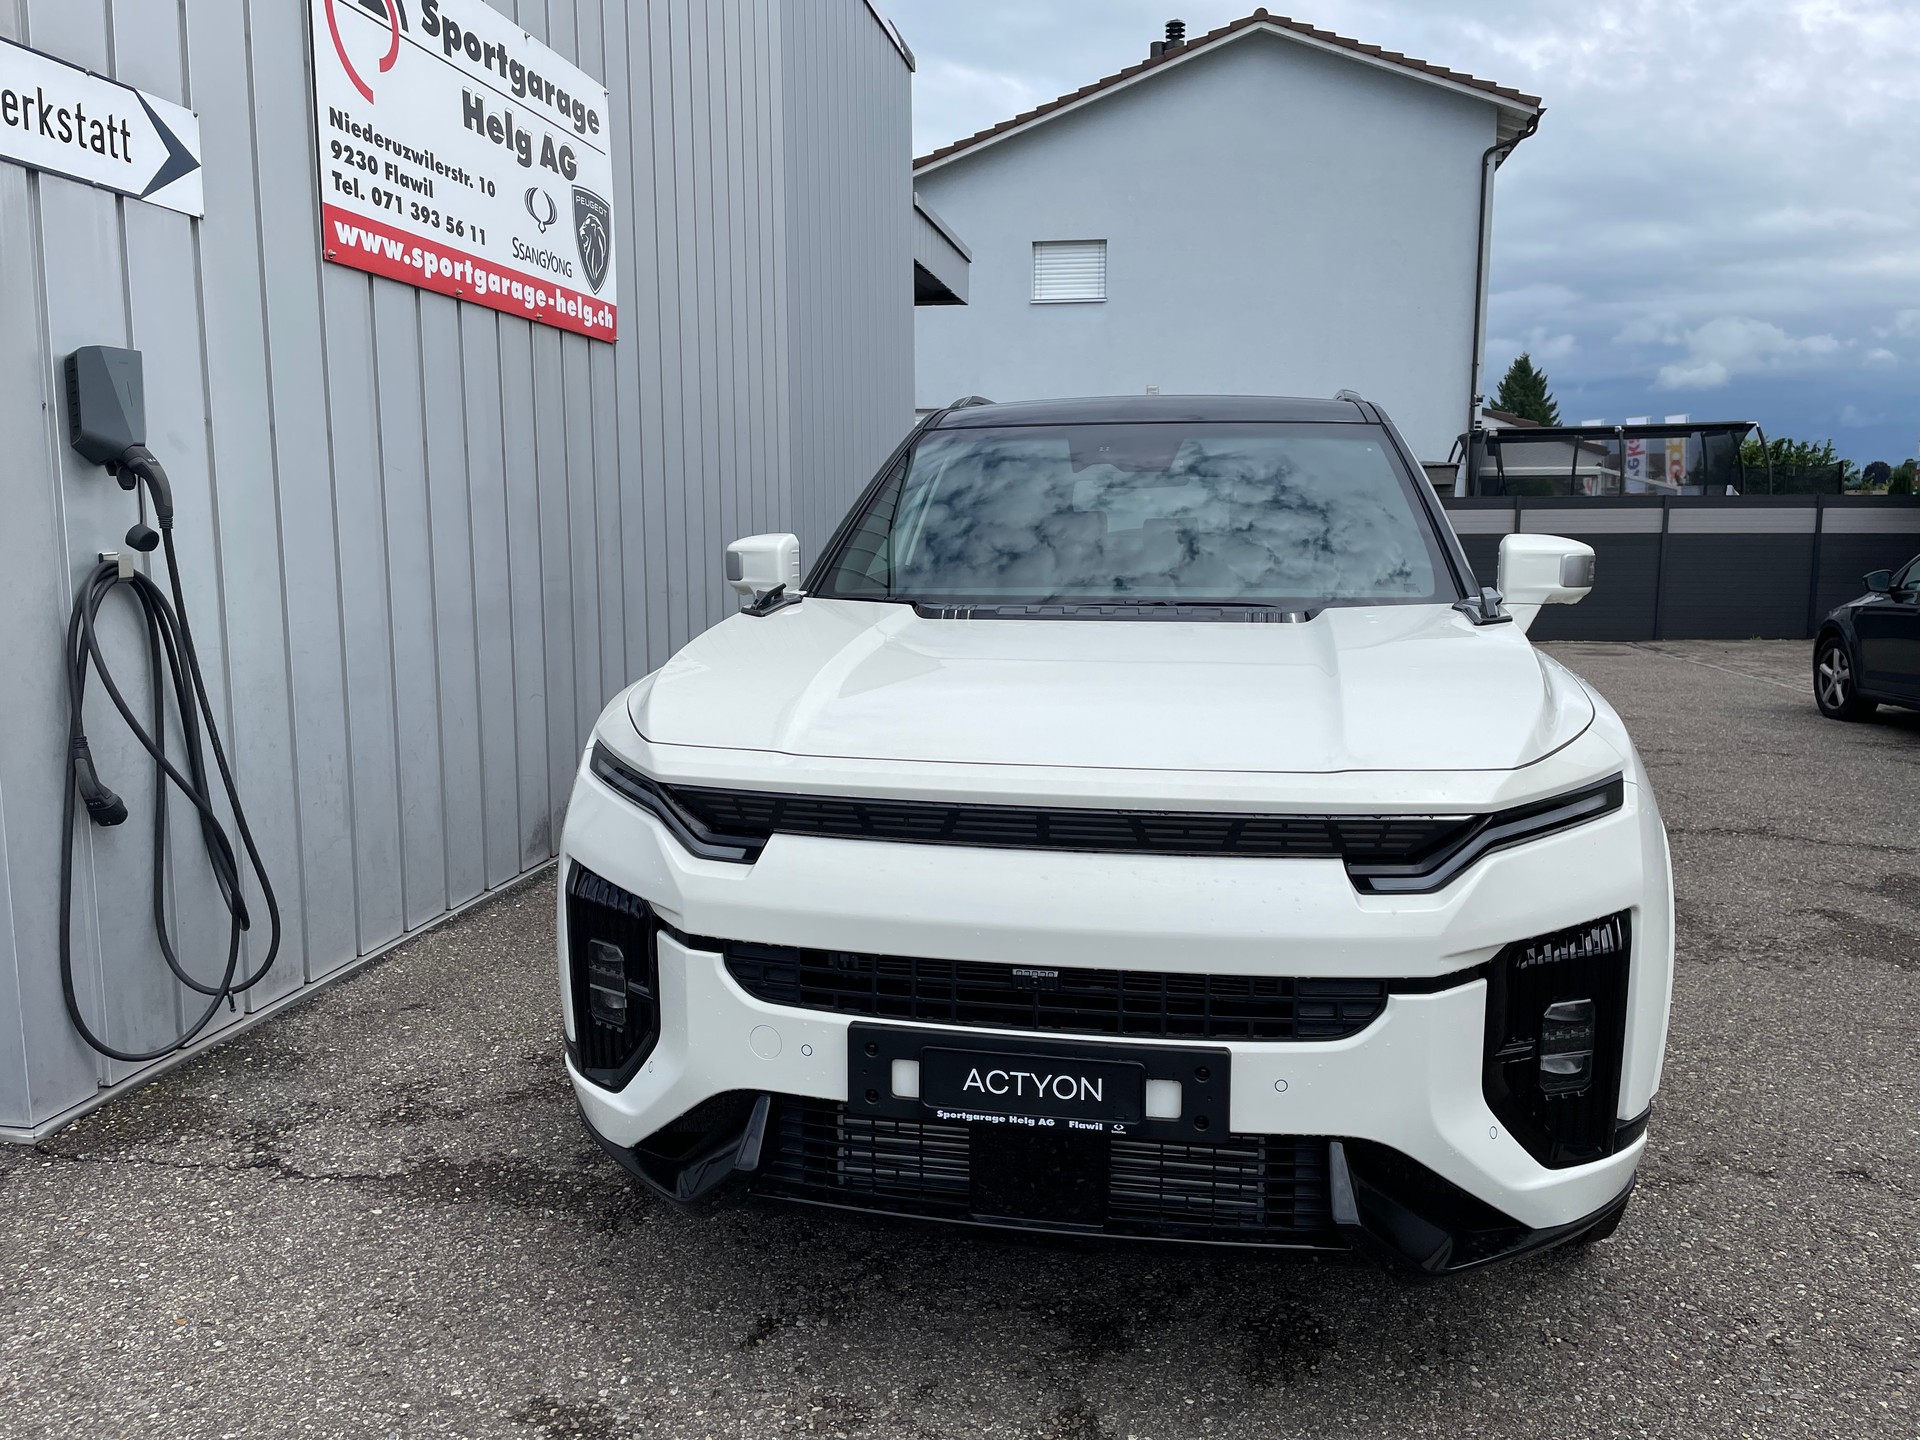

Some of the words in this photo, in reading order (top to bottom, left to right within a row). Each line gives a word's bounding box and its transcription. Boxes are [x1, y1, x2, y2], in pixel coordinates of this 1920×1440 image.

[421, 0, 600, 134] Sportgarage
[1, 86, 132, 163] erkstatt
[329, 106, 474, 188] Niederuzwilerstr.
[479, 176, 496, 198] 10
[462, 87, 533, 168] Helg
[540, 132, 578, 181] AG
[330, 139, 379, 175] 9230
[384, 161, 434, 199] Flawil
[331, 169, 366, 201] Tel.
[371, 187, 403, 215] 071
[410, 202, 441, 229] 393
[446, 215, 465, 237] 56
[470, 224, 486, 246] 11
[575, 195, 608, 218] PEUGEOT
[333, 221, 613, 329] www.sportgarage-helg.ch
[936, 1109, 1006, 1123] Sportgarage
[1008, 1115, 1036, 1127] Helg
[1038, 1118, 1056, 1127] AG
[1068, 1120, 1103, 1131] Flawil
[962, 1068, 1103, 1102] ACTYON
